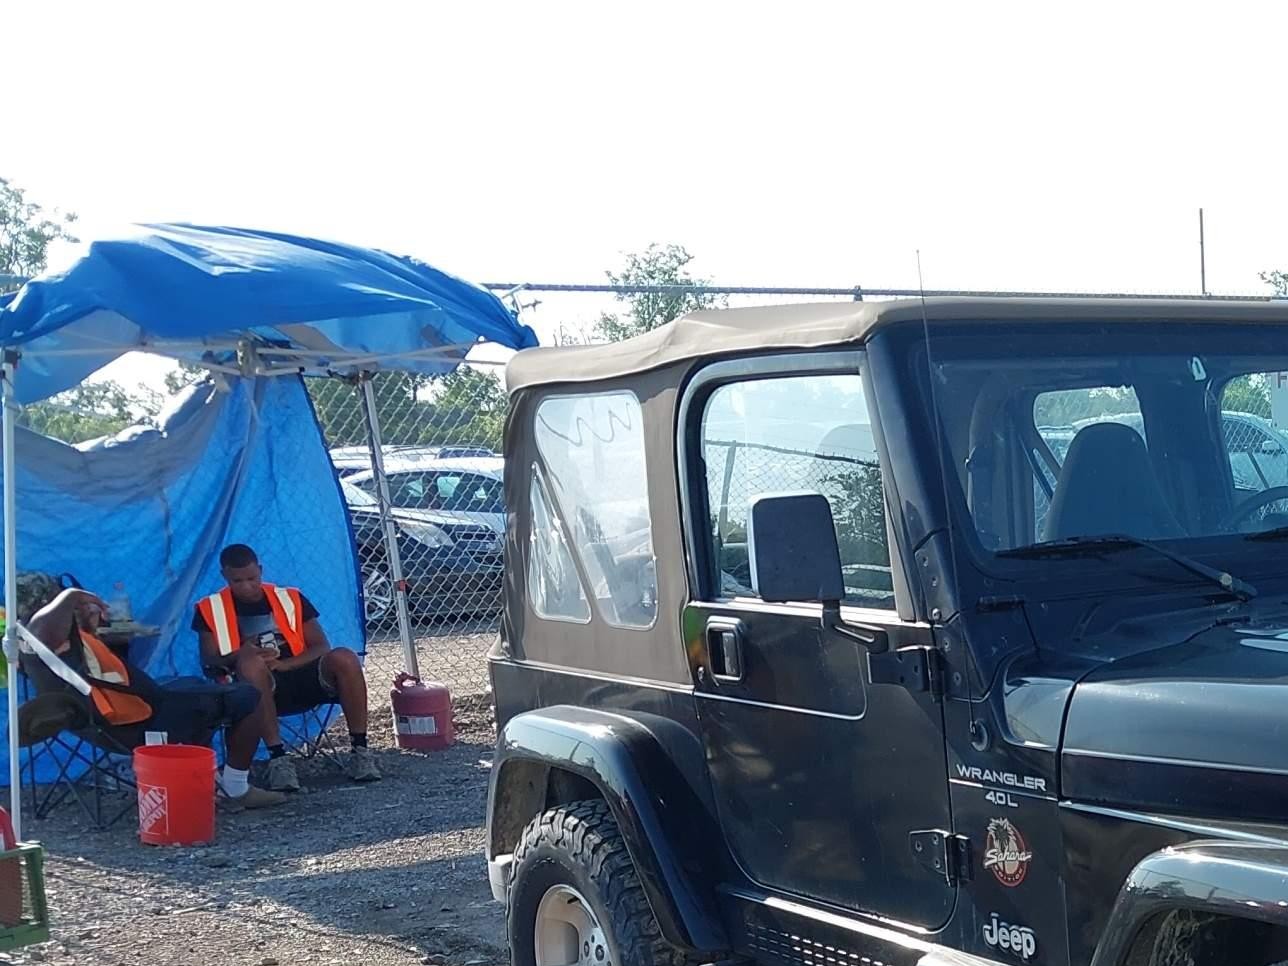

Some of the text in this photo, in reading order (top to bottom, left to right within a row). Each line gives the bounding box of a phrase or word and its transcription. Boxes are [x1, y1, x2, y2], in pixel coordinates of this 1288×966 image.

[956, 764, 1047, 791] WRANGLER
[984, 848, 1031, 866] Sahara
[983, 913, 1036, 959] Jeep
